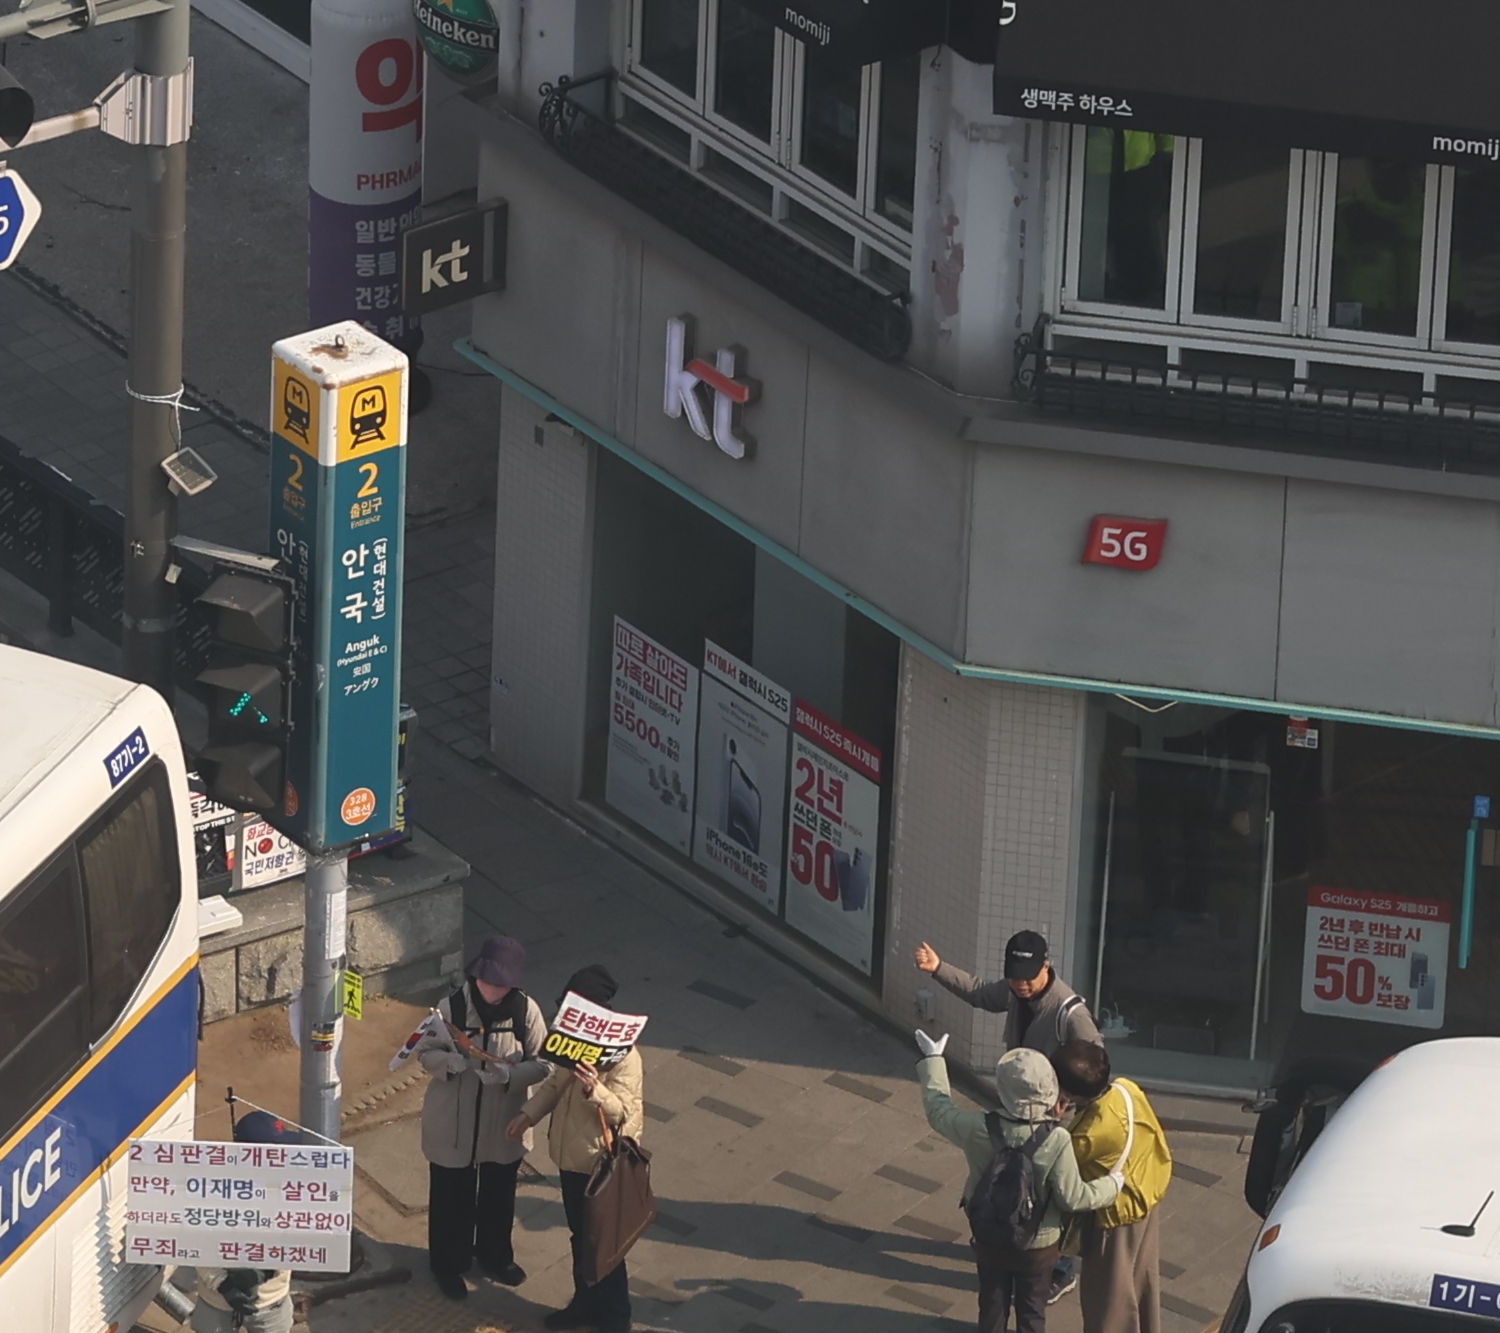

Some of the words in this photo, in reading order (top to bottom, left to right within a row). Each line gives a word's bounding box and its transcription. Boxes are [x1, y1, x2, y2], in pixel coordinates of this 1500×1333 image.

[785, 7, 830, 46] momiji
[1020, 87, 1075, 112] 생맥주
[1079, 92, 1133, 117] 하우스
[422, 239, 470, 294] kt
[664, 317, 750, 460] kt
[357, 462, 381, 498] 2
[350, 496, 382, 519] 출입구
[1100, 527, 1147, 561] 5G
[341, 544, 369, 624] 안국
[371, 537, 388, 619] (현대건설)
[344, 633, 380, 655] Anguk
[615, 652, 682, 712] 가족입니다
[766, 687, 789, 713] S25
[614, 703, 660, 749] 5500
[822, 723, 842, 749] S25
[111, 735, 145, 778] 87기-2
[795, 757, 845, 827] 2년
[791, 822, 840, 902] 50
[1320, 891, 1368, 910] Galaxy
[1370, 898, 1391, 911] S25
[1317, 933, 1350, 953] 쓰던
[1319, 915, 1345, 934] 2년
[1348, 919, 1364, 936] 후
[1405, 924, 1422, 942] 시
[1313, 954, 1376, 1005] 50
[1377, 975, 1392, 991] %
[560, 1007, 641, 1044] 탄핵무효
[545, 1032, 603, 1065] 이재명
[130, 1146, 143, 1162] 2
[180, 1145, 239, 1168] 판결이
[241, 1145, 351, 1170] 개탄스럽다
[130, 1175, 177, 1197] 만약,
[185, 1176, 267, 1202] 이재명이
[273, 1210, 351, 1233] 상관없이
[220, 1241, 328, 1265] 판결하겠네
